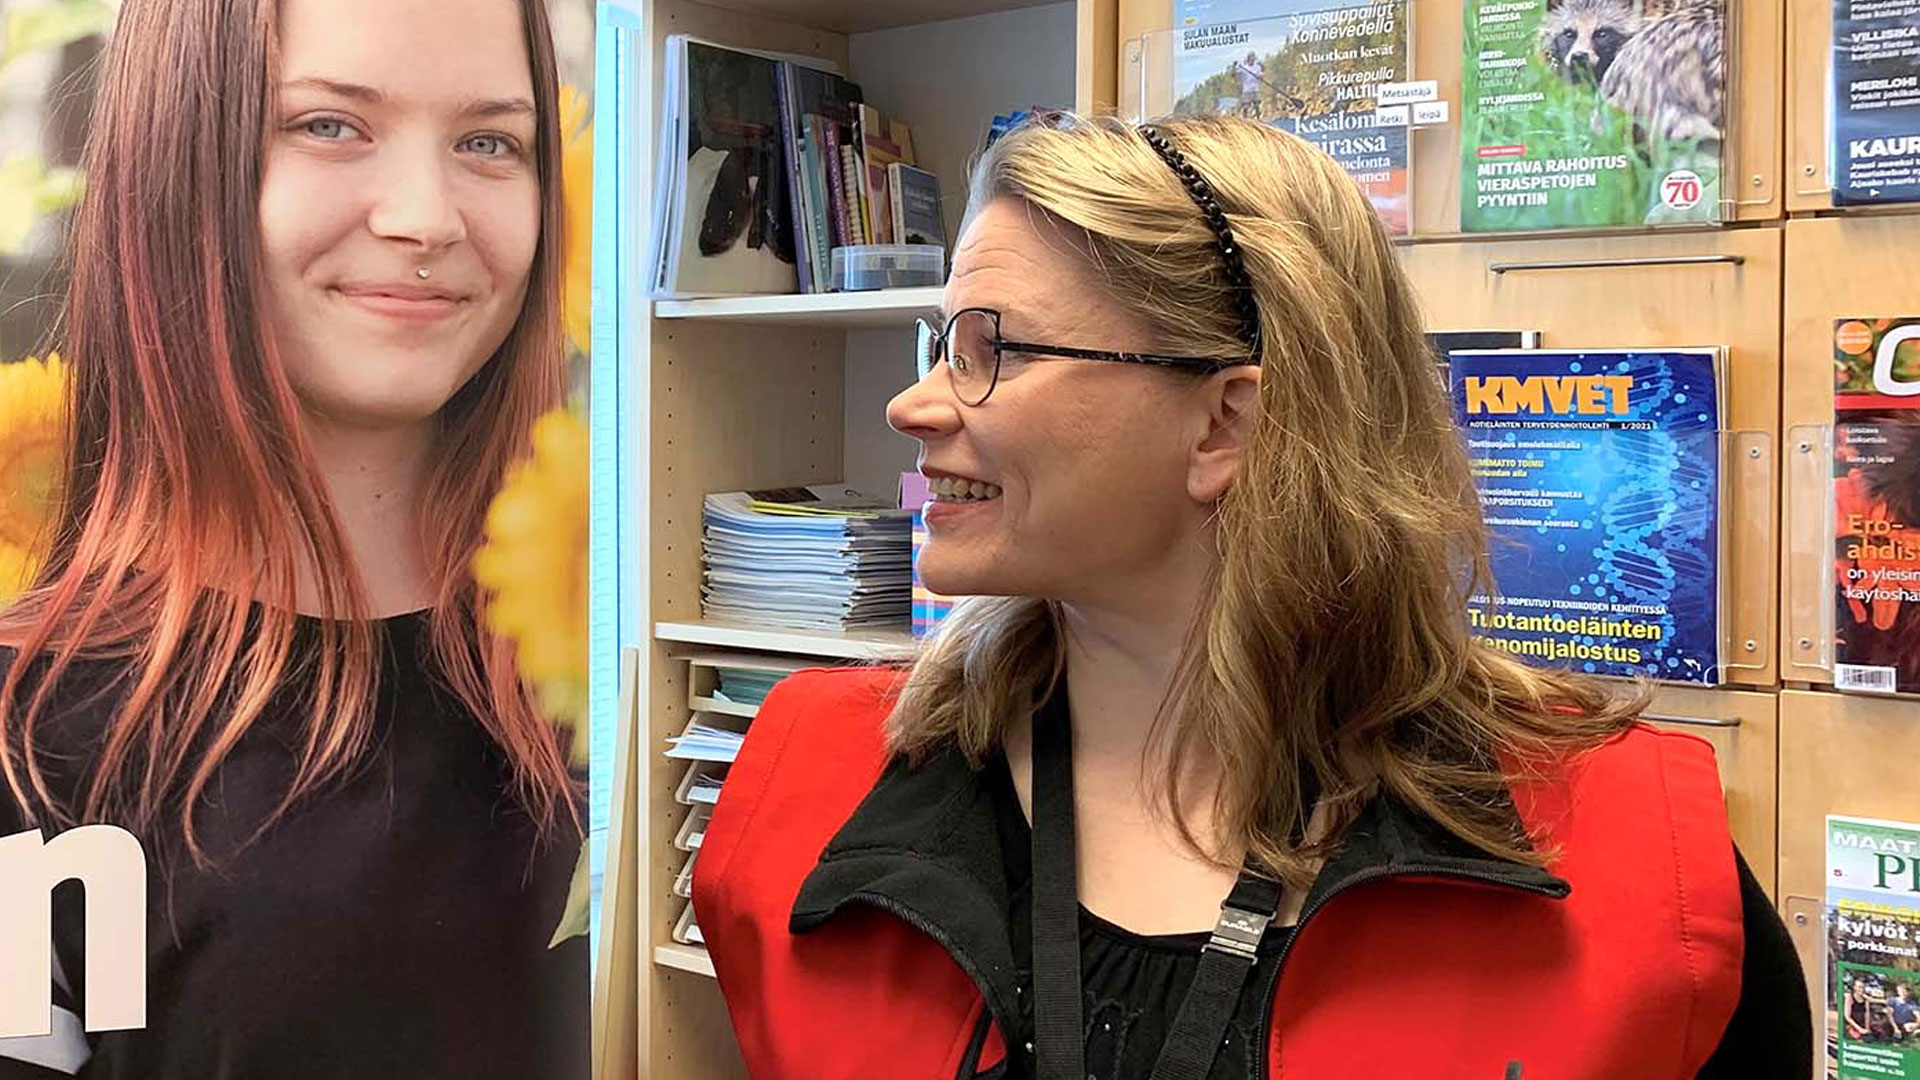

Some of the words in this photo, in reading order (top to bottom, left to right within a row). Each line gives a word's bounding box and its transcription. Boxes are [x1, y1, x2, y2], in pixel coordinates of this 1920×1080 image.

[1289, 2, 1394, 28] Suvisuppailut
[1211, 25, 1237, 36] MAAN
[1291, 16, 1394, 44] Konnevedellä
[1851, 27, 1919, 42] VILLISIKA
[1184, 33, 1250, 50] MAKUUALUSTAT
[1300, 48, 1358, 64] Muotkan
[1361, 44, 1395, 58] kevät
[1318, 66, 1395, 87] Pikkurepulla
[1850, 76, 1918, 92] MERILOHI
[1380, 114, 1403, 123] Retki
[1850, 136, 1920, 158] KAUR
[1477, 160, 1543, 176] MITTAVA
[1545, 155, 1627, 172] RAHOITUS
[1477, 174, 1597, 192] VIERASPETOJEN
[1666, 181, 1699, 203] 70
[1477, 192, 1548, 208] PYYNTIIN
[1465, 375, 1634, 414] KMVET
[1848, 513, 1904, 535] Ero-
[1847, 567, 1868, 580] on
[1507, 598, 1551, 609] NOPEUTUU
[1611, 602, 1667, 615] KEHITTYESSÄ
[1468, 608, 1662, 641] Tuotantoeläinten
[1838, 915, 1909, 940] kylvöt
[1847, 941, 1919, 958] porkkanat
